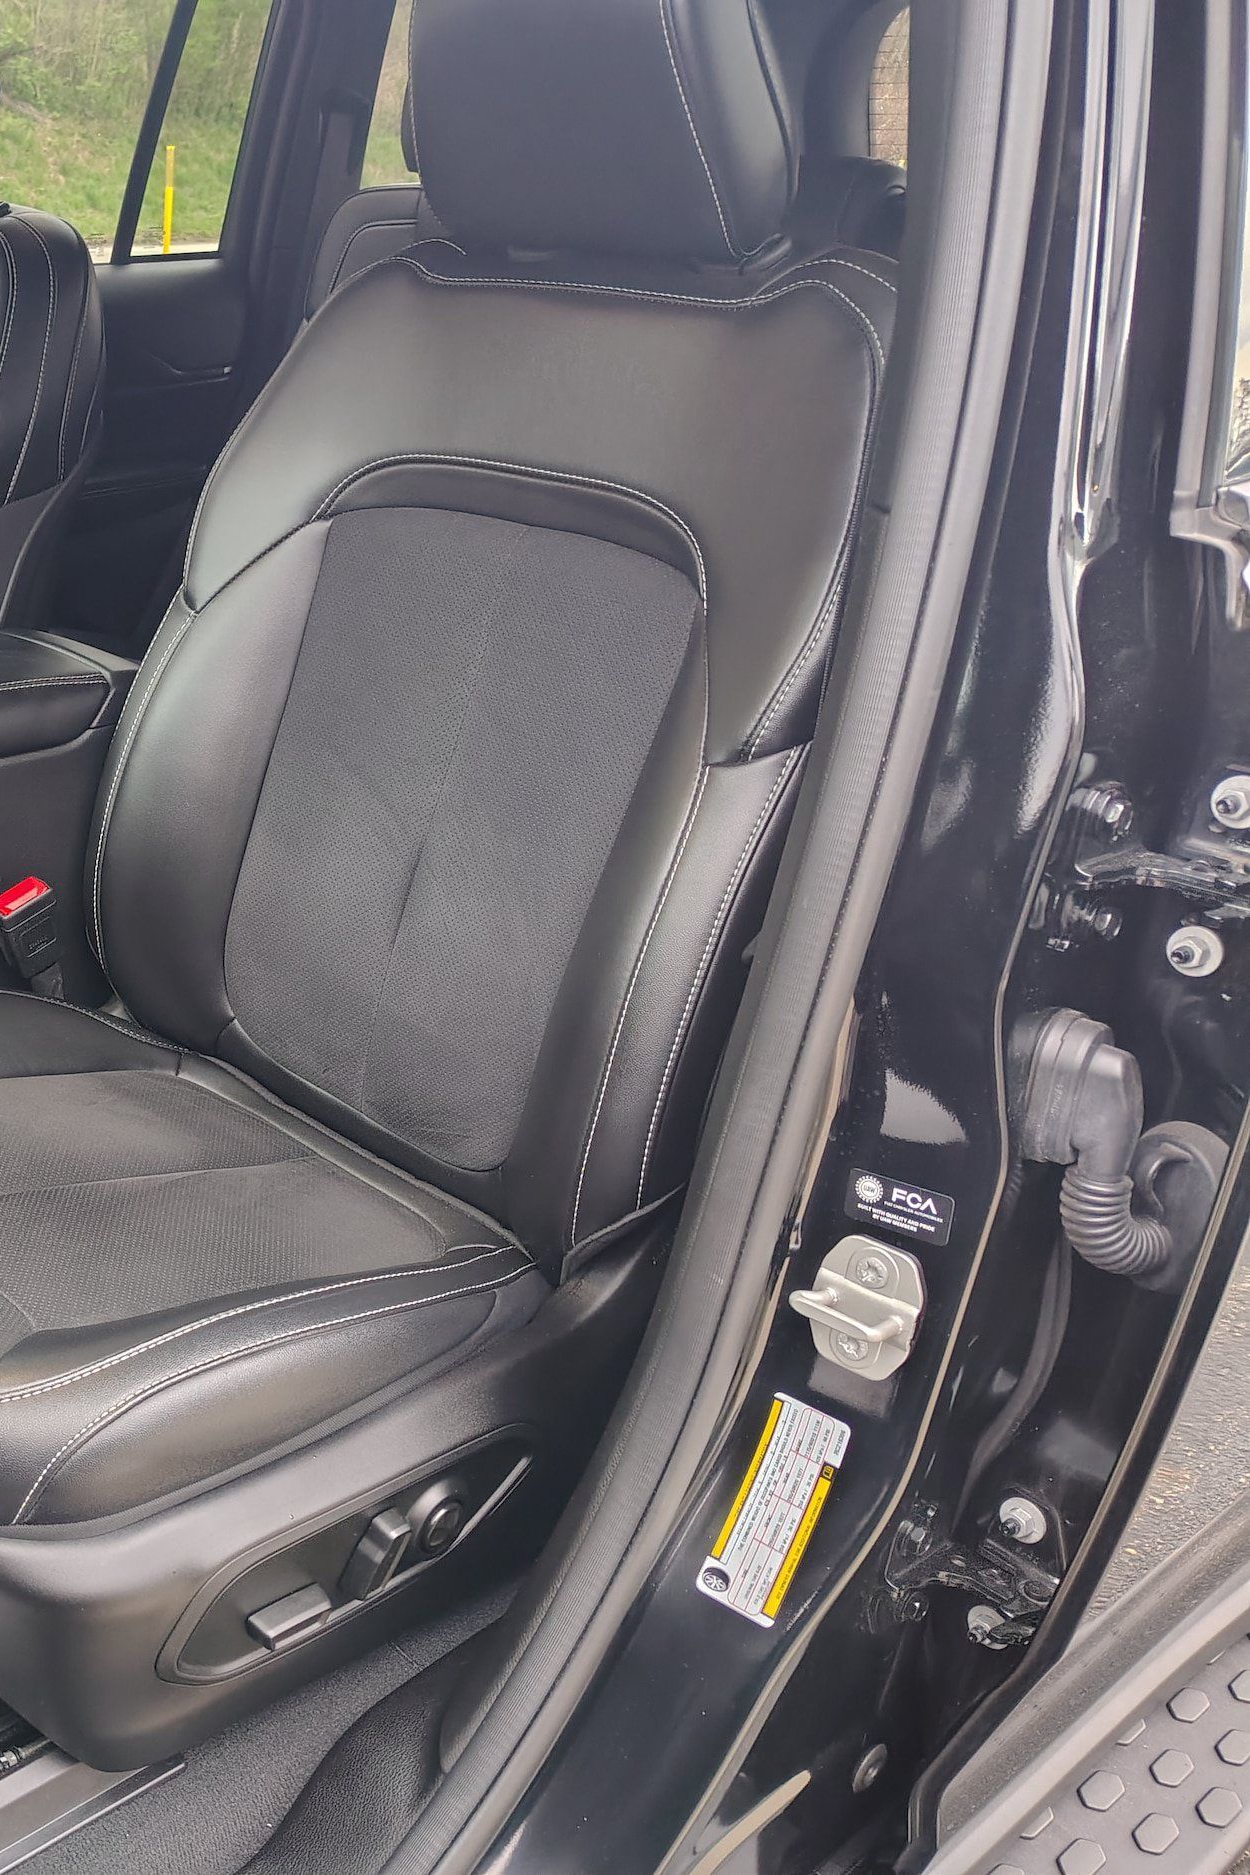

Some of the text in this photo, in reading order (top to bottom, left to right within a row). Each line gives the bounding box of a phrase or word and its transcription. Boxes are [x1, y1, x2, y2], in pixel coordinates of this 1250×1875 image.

[892, 1188, 937, 1215] FCA
[857, 1203, 935, 1232] BUILT WITH QUALITY AND PRIDE
[880, 1216, 892, 1224] UAW
[892, 1219, 917, 1232] MEMBERS
